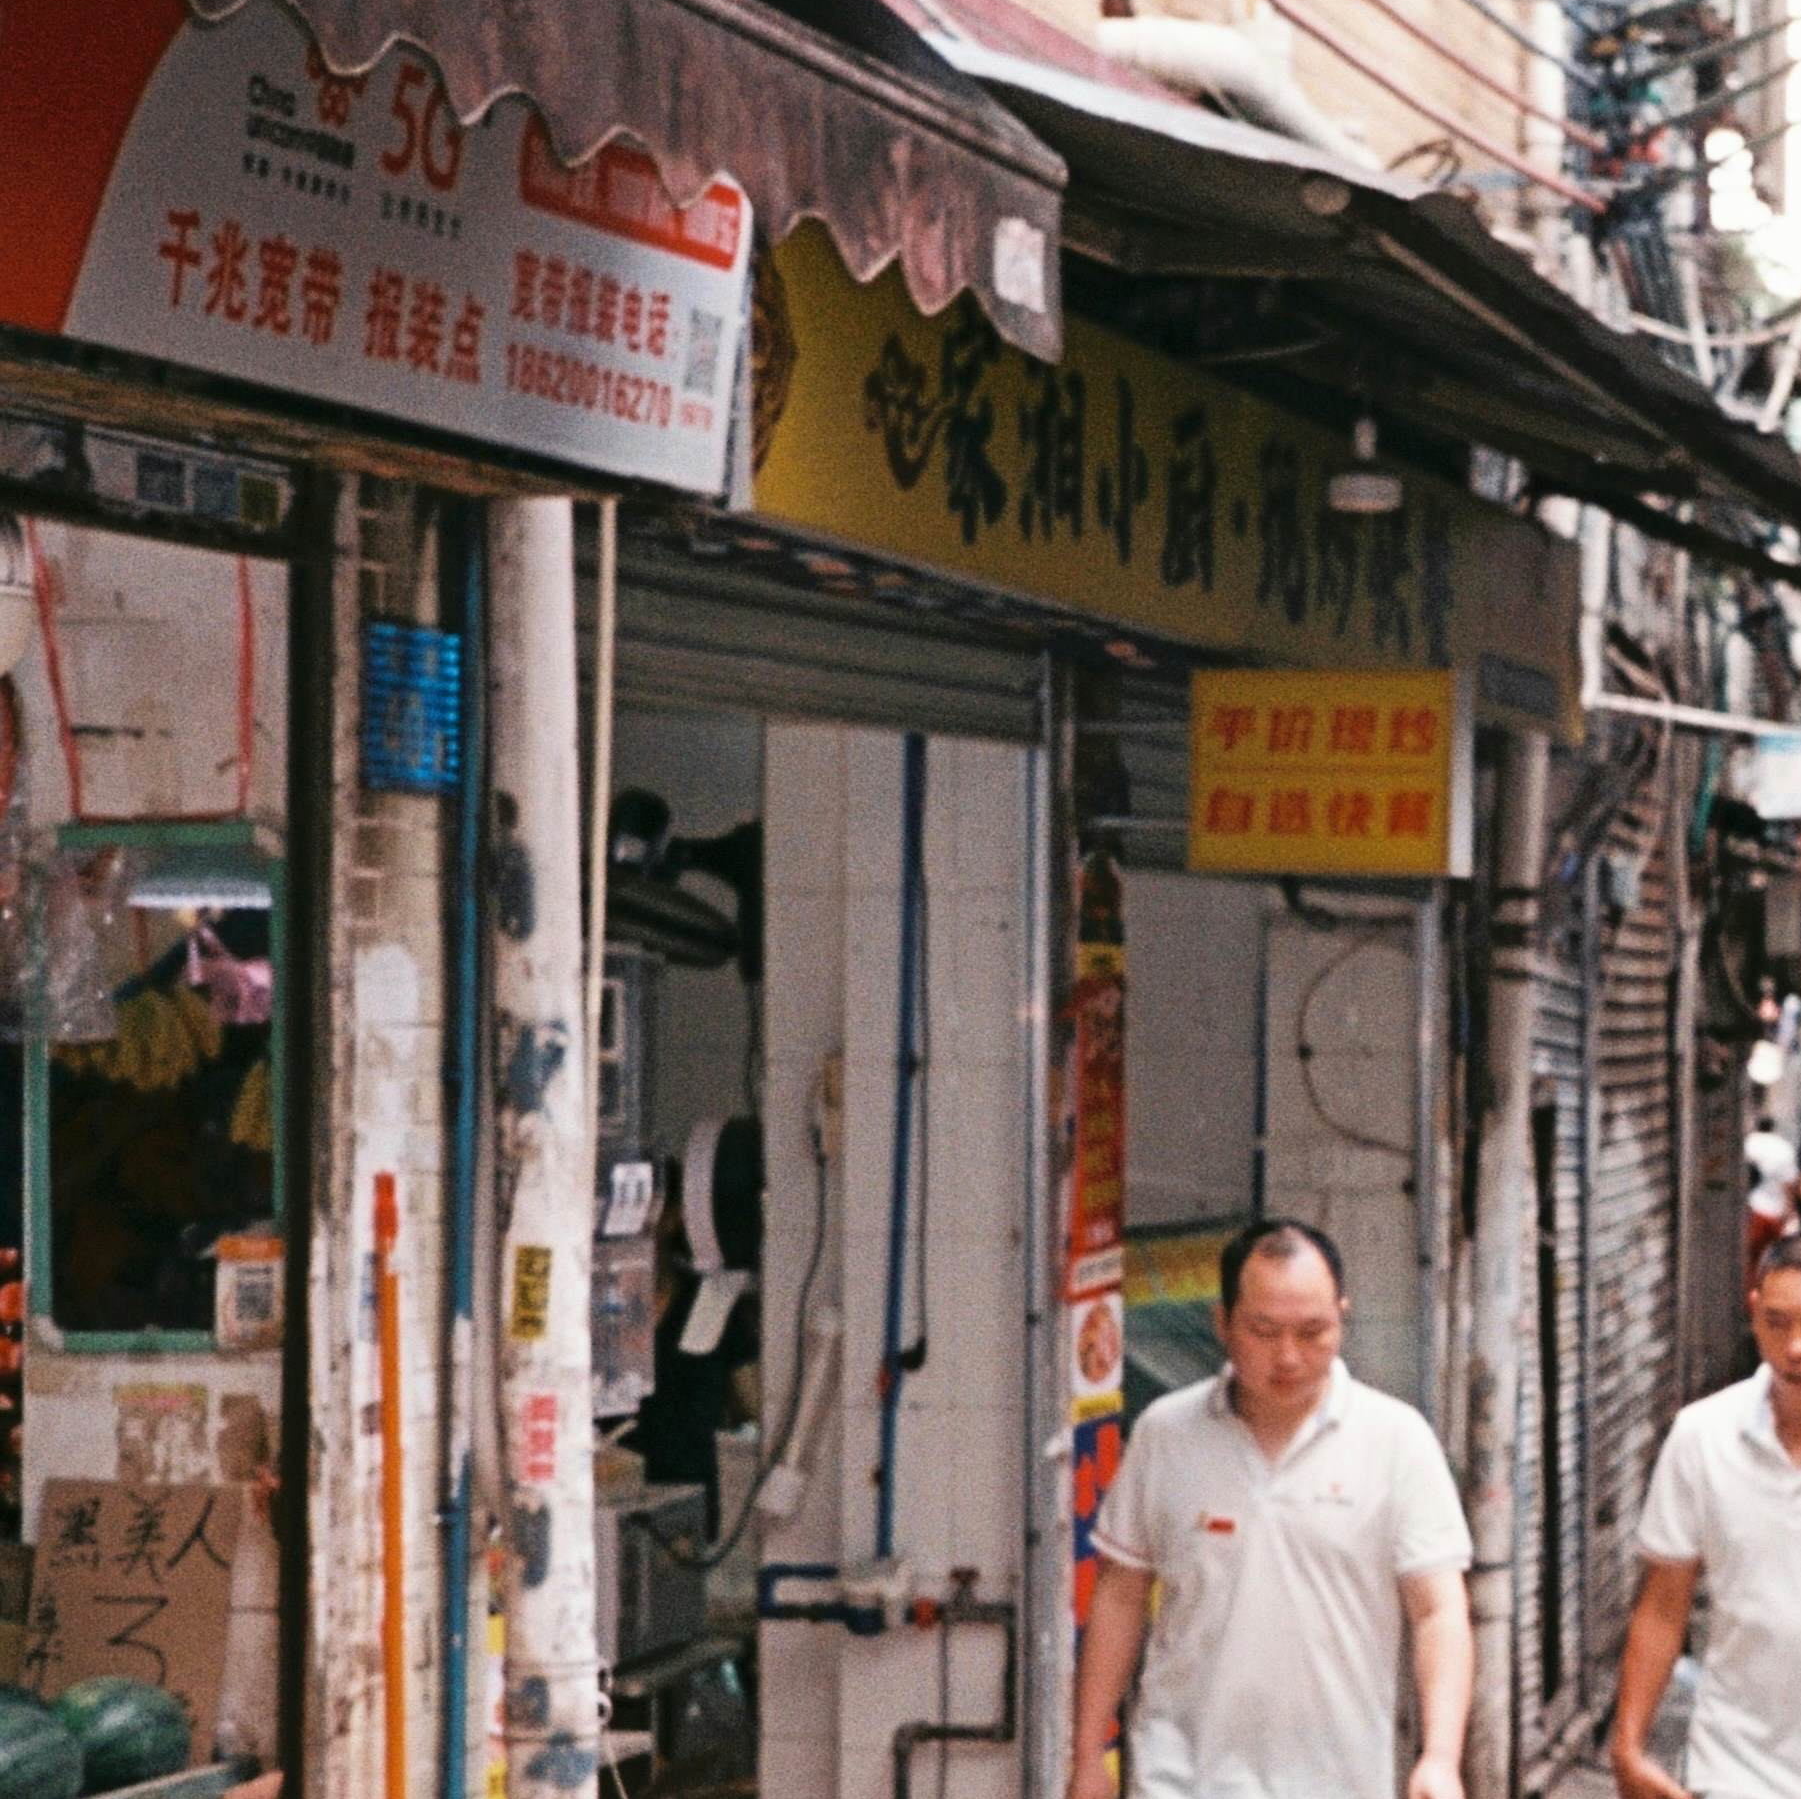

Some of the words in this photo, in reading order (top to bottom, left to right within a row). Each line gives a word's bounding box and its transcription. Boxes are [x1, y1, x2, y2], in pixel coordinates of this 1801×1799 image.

[382, 62, 463, 191] 5G
[157, 208, 343, 345] 千兆宽带
[364, 266, 485, 385] 报装点
[48, 1488, 232, 1585] 黑美人
